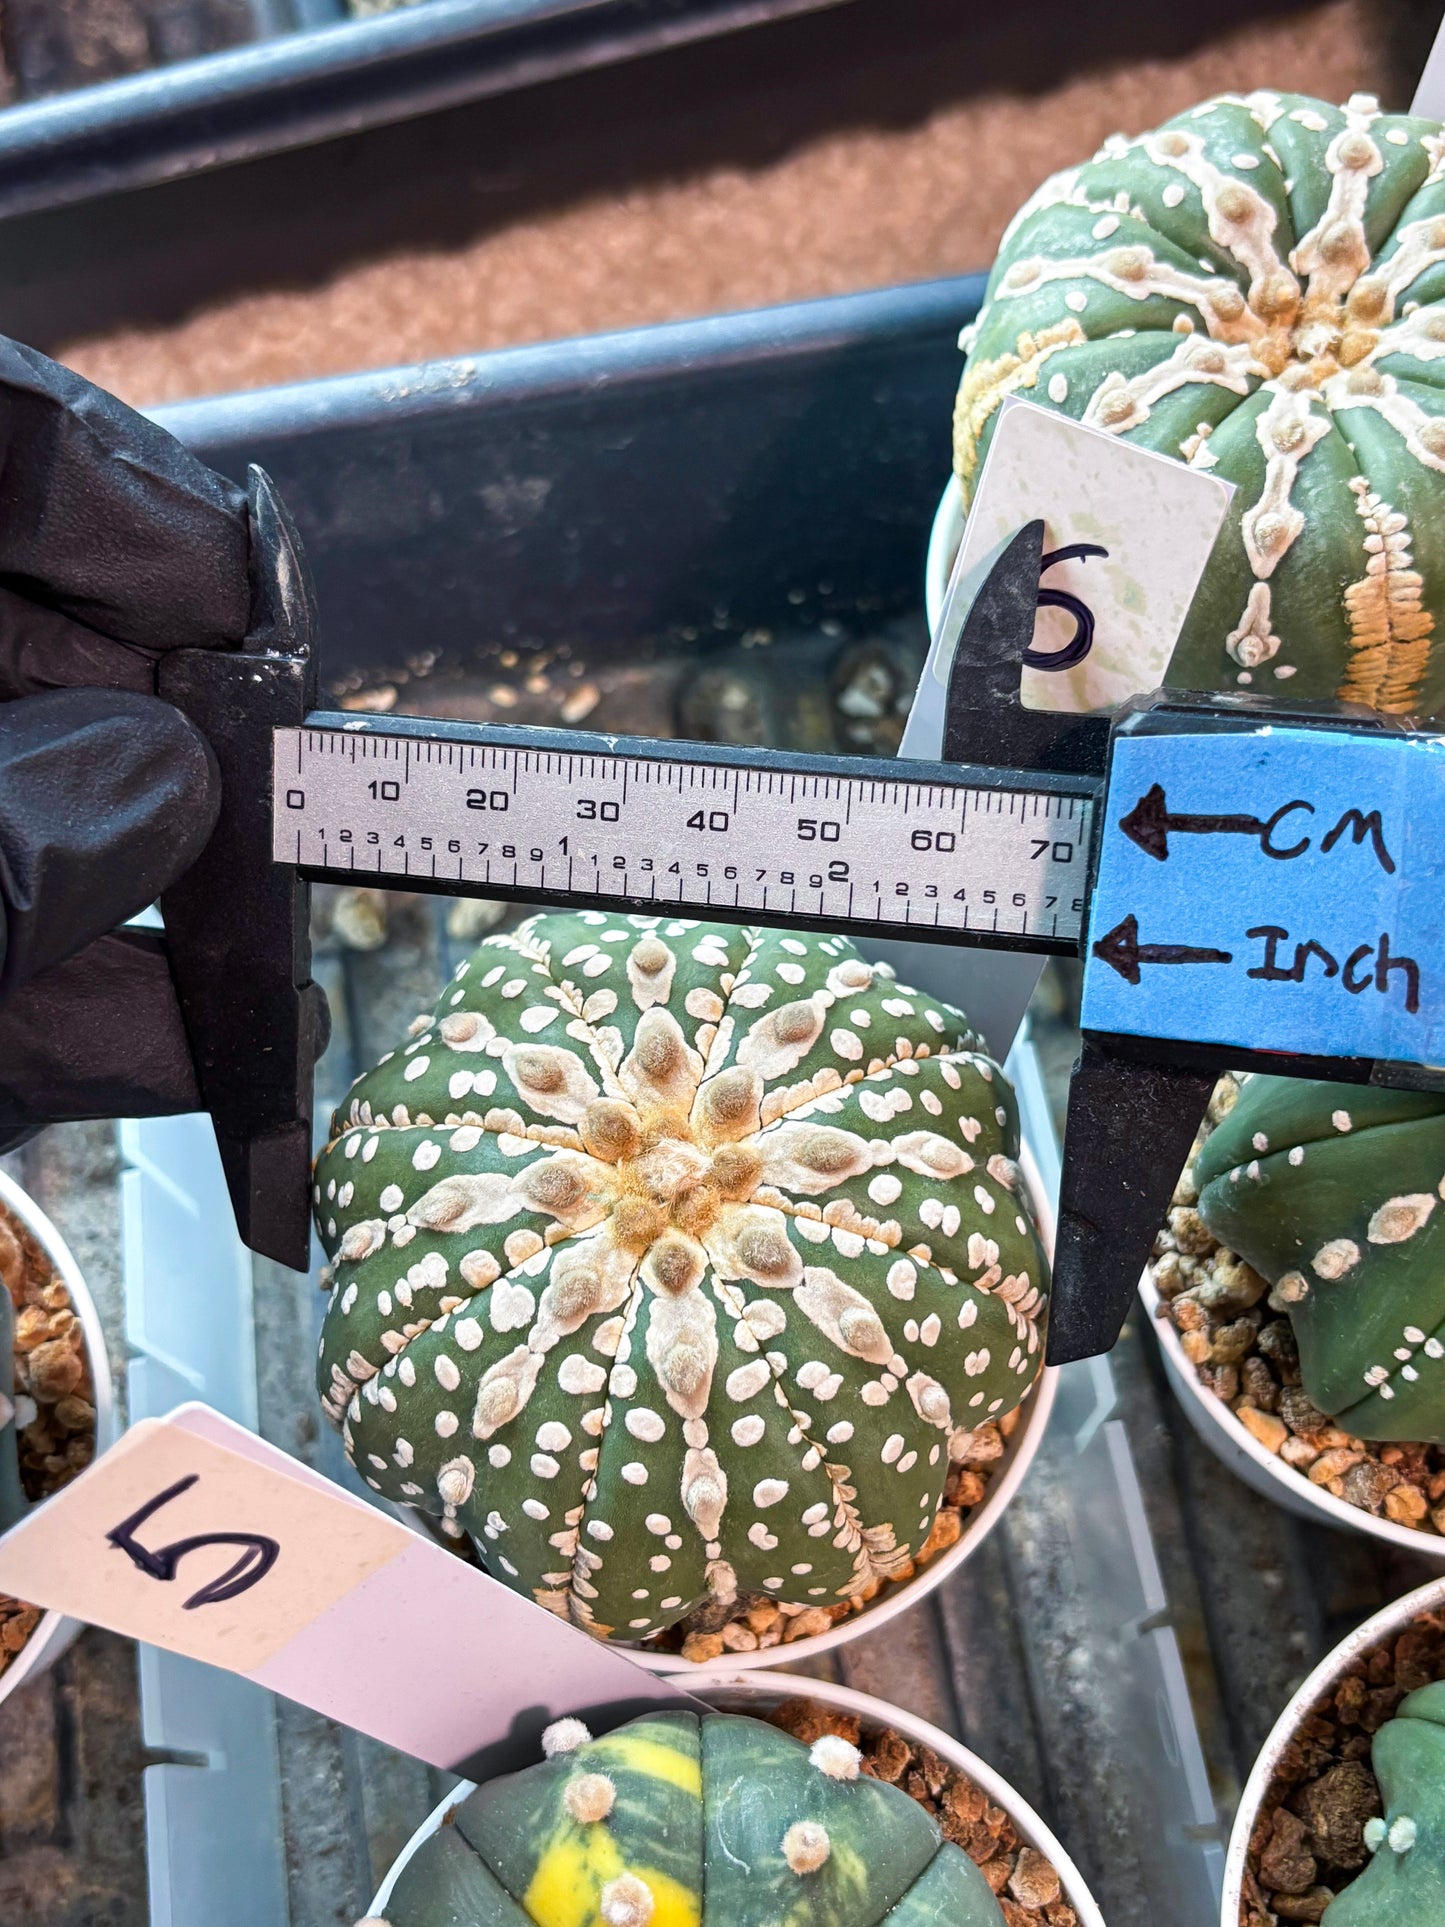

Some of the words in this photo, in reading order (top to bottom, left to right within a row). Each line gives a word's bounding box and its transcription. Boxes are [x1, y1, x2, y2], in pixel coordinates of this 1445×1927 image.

[286, 789, 305, 810] 0
[367, 780, 400, 802] 10
[466, 788, 509, 812] 20
[576, 799, 620, 823] 30
[686, 810, 729, 832] 40
[797, 818, 840, 843] 50
[910, 829, 956, 853] 60
[1030, 839, 1073, 863] 70
[318, 828, 325, 840] 1
[339, 829, 353, 843] 2
[366, 831, 380, 845] 3
[393, 835, 406, 848] 4
[420, 837, 433, 851] 5
[447, 839, 461, 854] 6
[477, 842, 489, 855] 7
[502, 845, 516, 858] 8
[529, 848, 544, 862] 9
[558, 835, 568, 856] 1
[590, 854, 598, 867] 1
[612, 856, 626, 870] 2
[640, 858, 654, 871] 3
[668, 861, 681, 875] 4
[696, 863, 709, 877] 5
[724, 866, 738, 880] 6
[755, 869, 767, 882] 7
[780, 871, 795, 885] 8
[809, 874, 823, 889] 9
[828, 860, 850, 883] 2
[872, 880, 880, 893] 1
[895, 882, 910, 896] 2
[924, 885, 938, 898] 3
[953, 888, 966, 902] 4
[983, 890, 997, 904] 5
[1012, 893, 1026, 907] 6
[1045, 895, 1058, 909] 7
[1246, 925, 1419, 1013] Inch
[104, 1473, 280, 1610] 5
